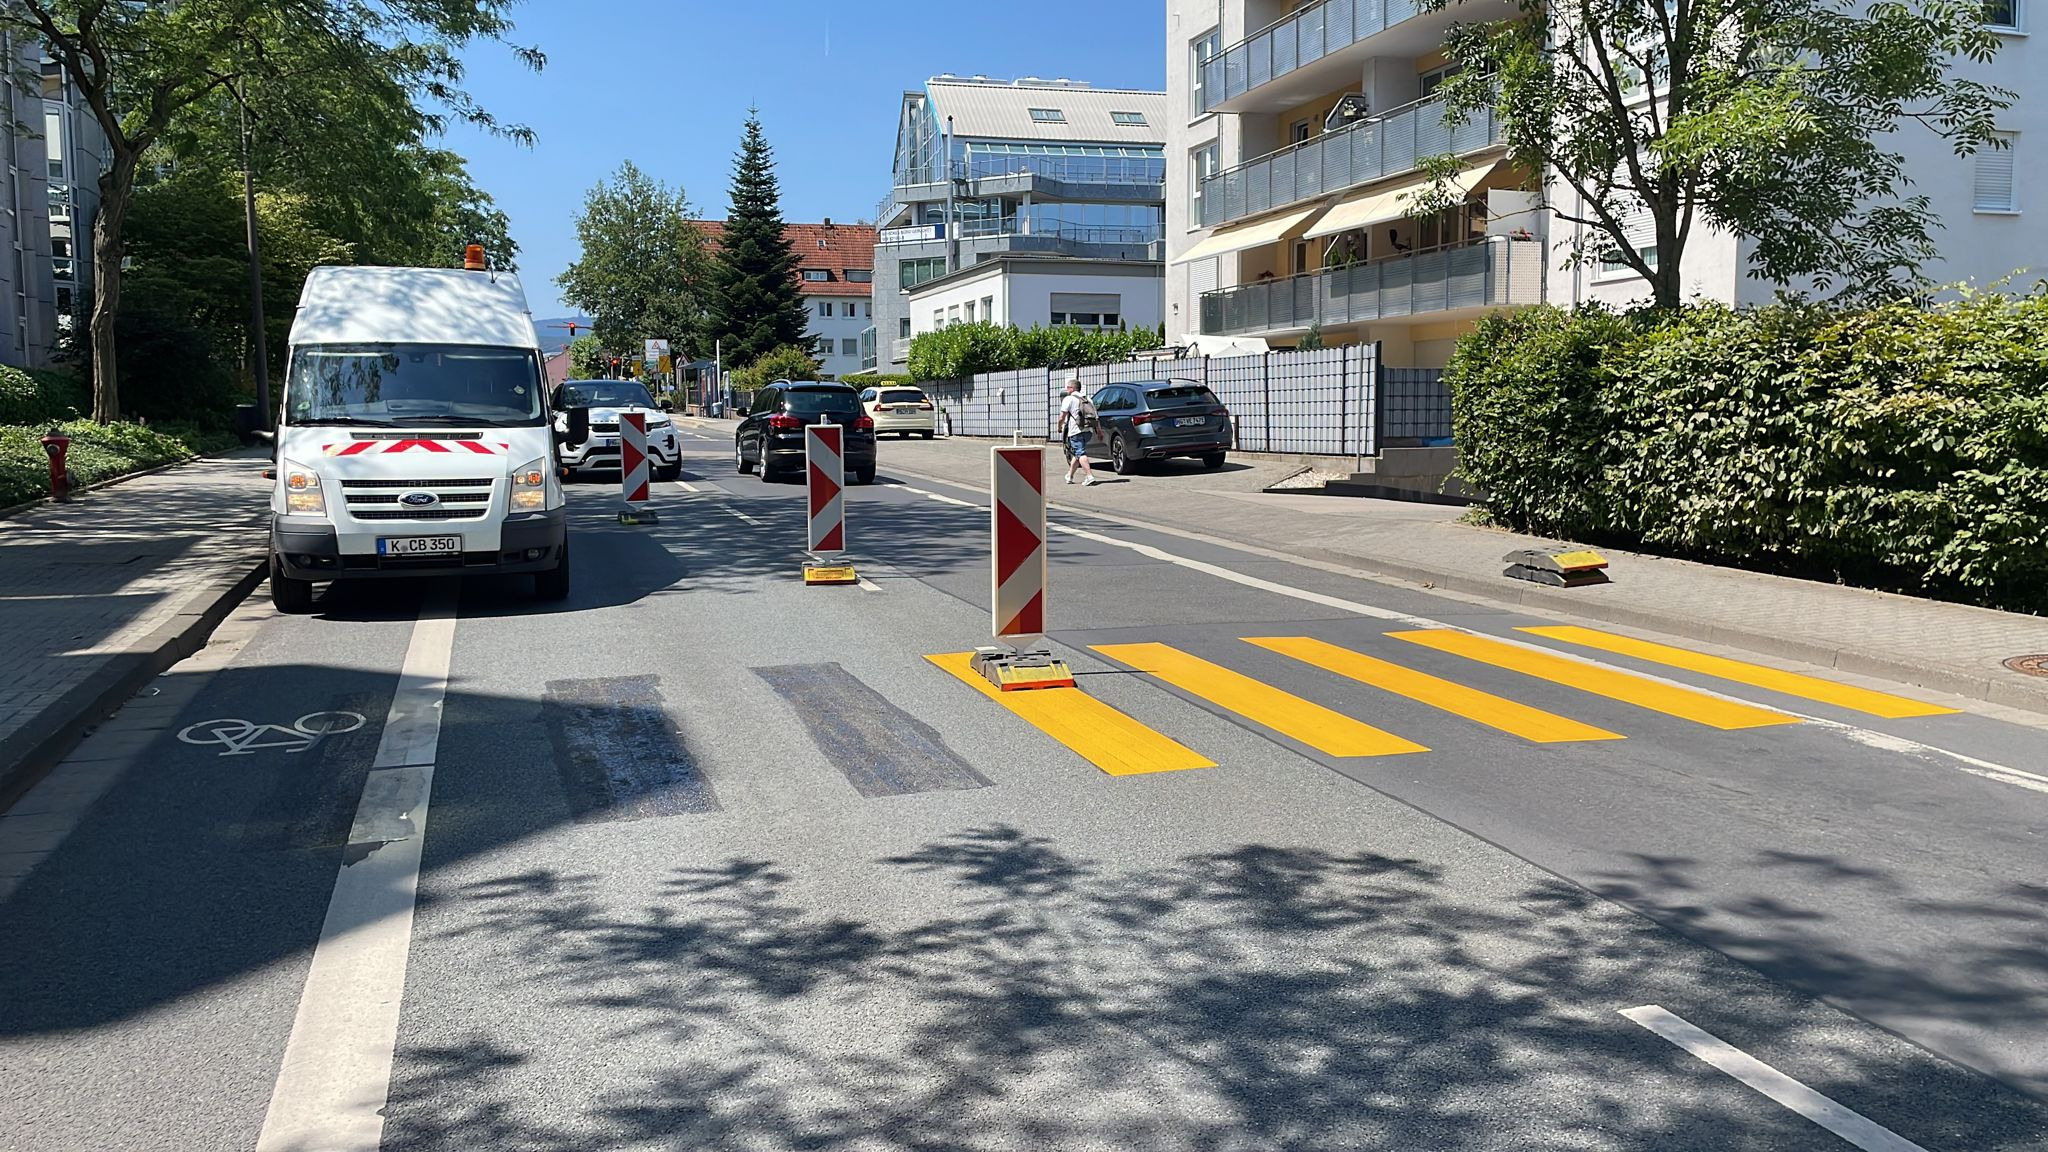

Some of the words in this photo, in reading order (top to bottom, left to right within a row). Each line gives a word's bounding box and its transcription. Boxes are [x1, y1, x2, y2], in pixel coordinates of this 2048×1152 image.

[408, 494, 429, 504] Ford
[391, 540, 400, 552] K
[409, 539, 427, 551] CB
[430, 538, 455, 550] 350
